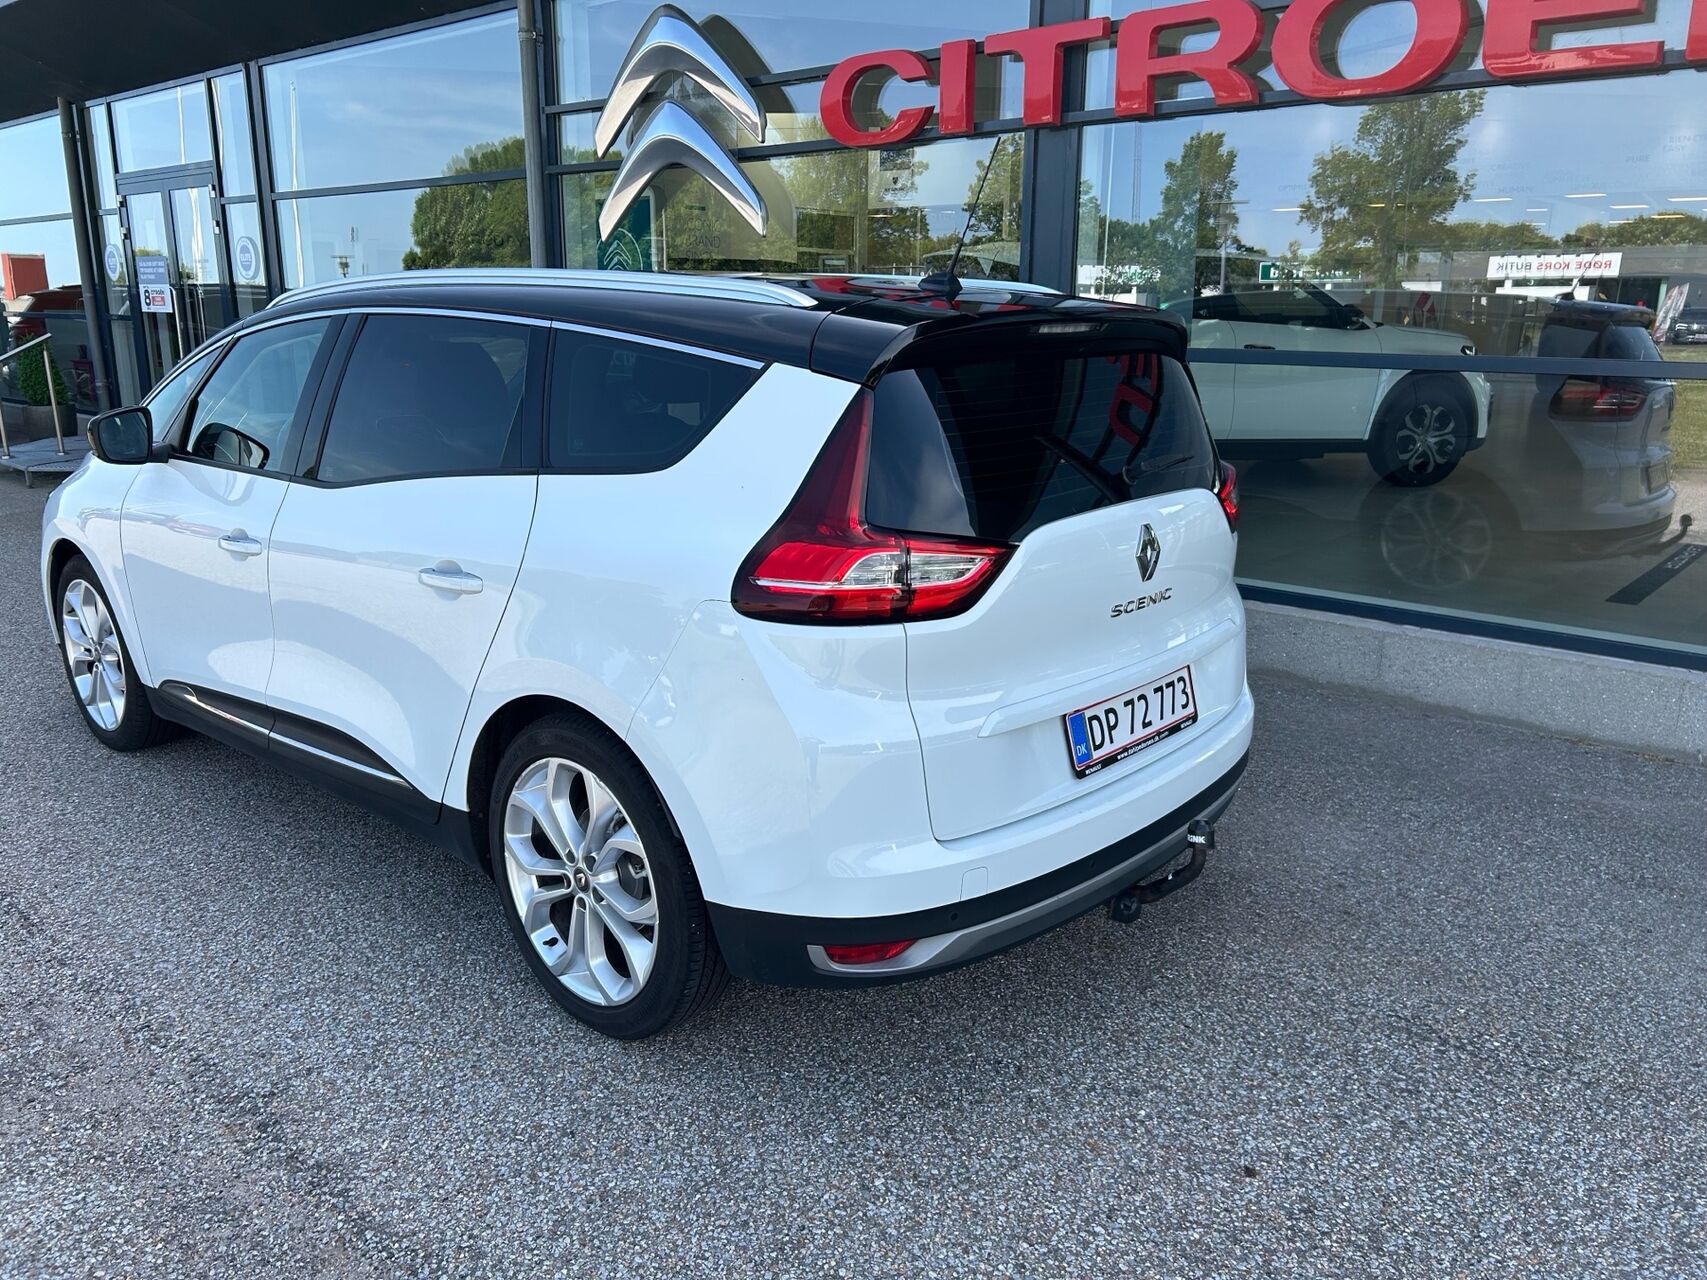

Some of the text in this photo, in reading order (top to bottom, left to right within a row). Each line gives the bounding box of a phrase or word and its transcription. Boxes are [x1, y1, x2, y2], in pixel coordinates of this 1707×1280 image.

[819, 0, 1707, 148] CITROE
[1110, 587, 1173, 618] SCENIC
[1087, 675, 1190, 752] DP 72 773
[1076, 743, 1088, 757] DK
